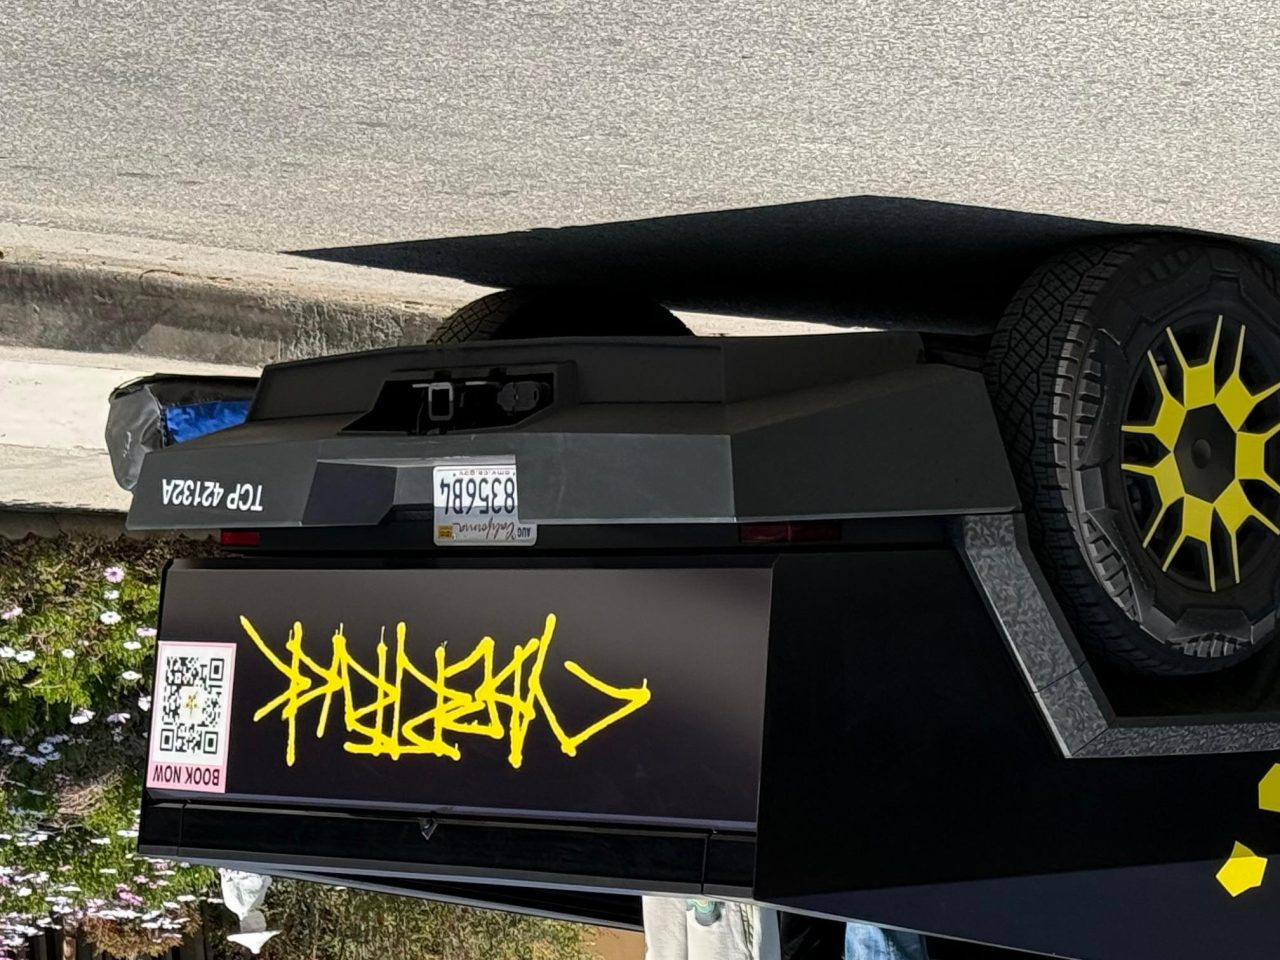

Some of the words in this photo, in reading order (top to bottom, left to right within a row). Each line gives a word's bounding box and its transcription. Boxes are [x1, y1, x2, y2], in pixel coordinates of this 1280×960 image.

[162, 479, 224, 506] 42132A
[226, 484, 263, 511] TCP
[440, 478, 515, 515] 8356B4
[453, 516, 516, 540] California
[517, 527, 530, 538] AUG
[152, 764, 182, 784] NOW
[184, 766, 220, 786] BOOK
